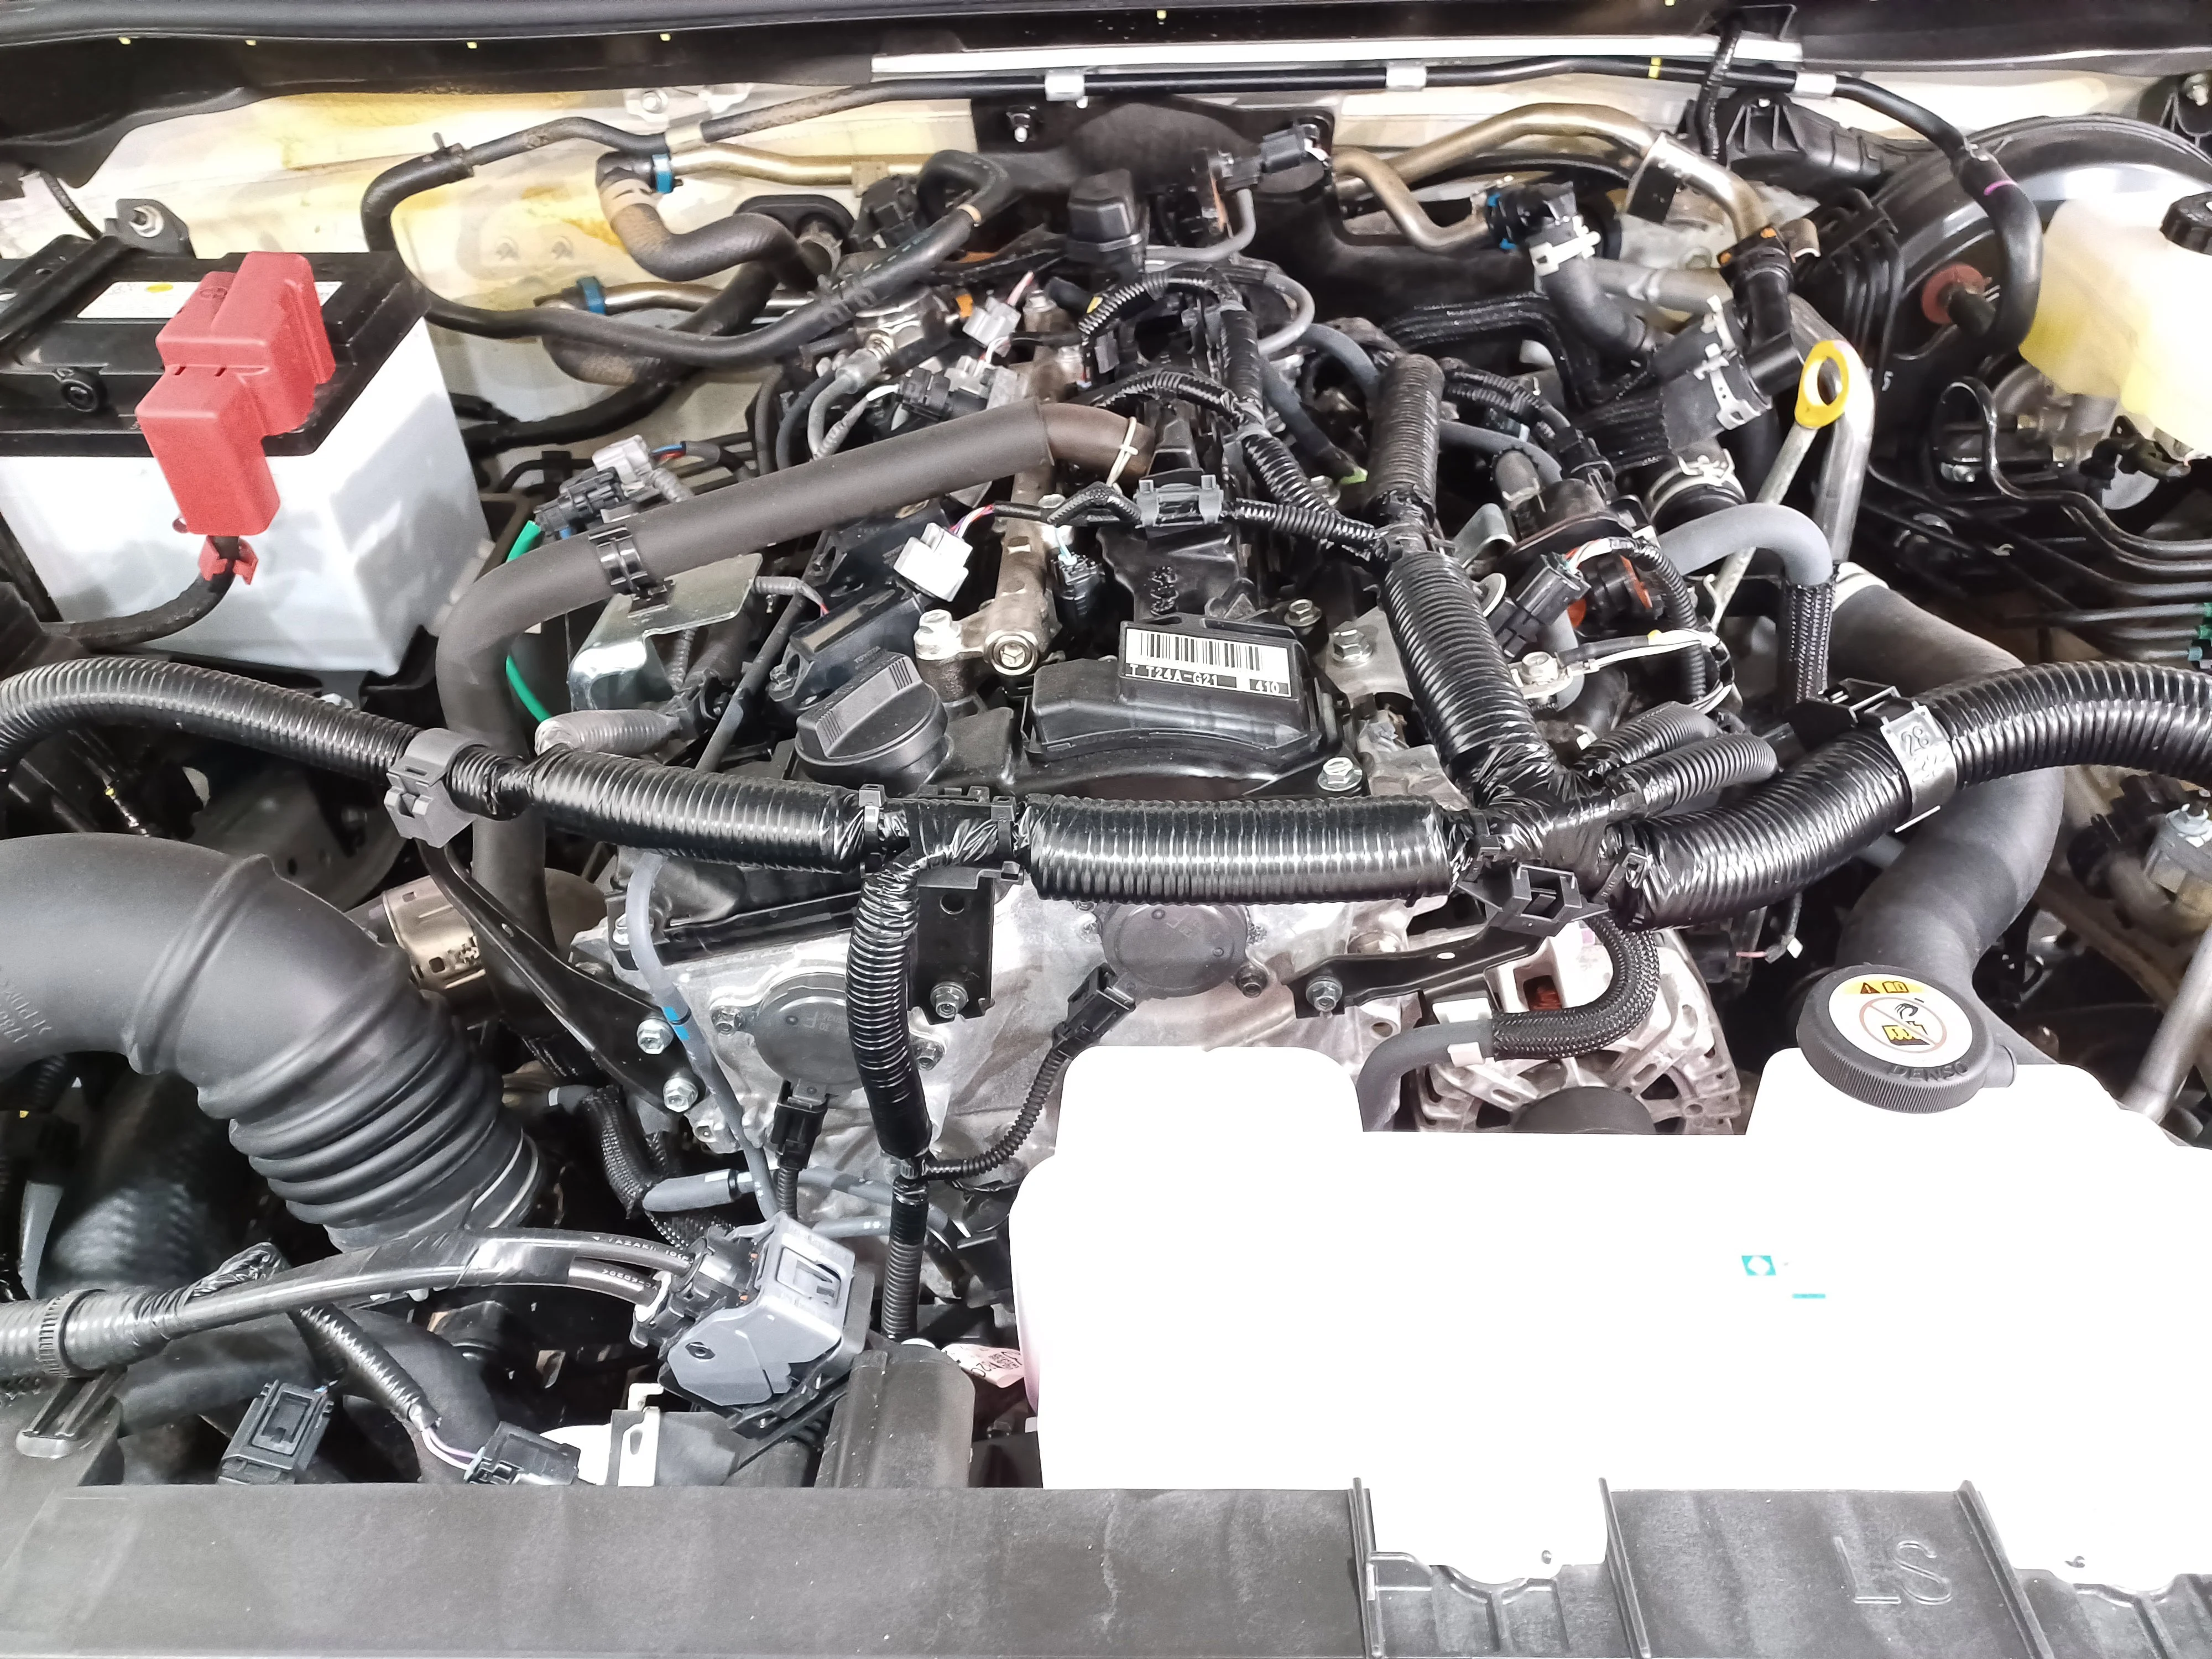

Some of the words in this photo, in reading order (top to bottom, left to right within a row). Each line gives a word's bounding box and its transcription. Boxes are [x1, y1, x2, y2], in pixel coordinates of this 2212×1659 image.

[1146, 665, 1218, 686] T24A-G21
[1255, 680, 1280, 694] 410
[1888, 1061, 1969, 1082] DENSO
[1832, 1536, 1953, 1606] LS
